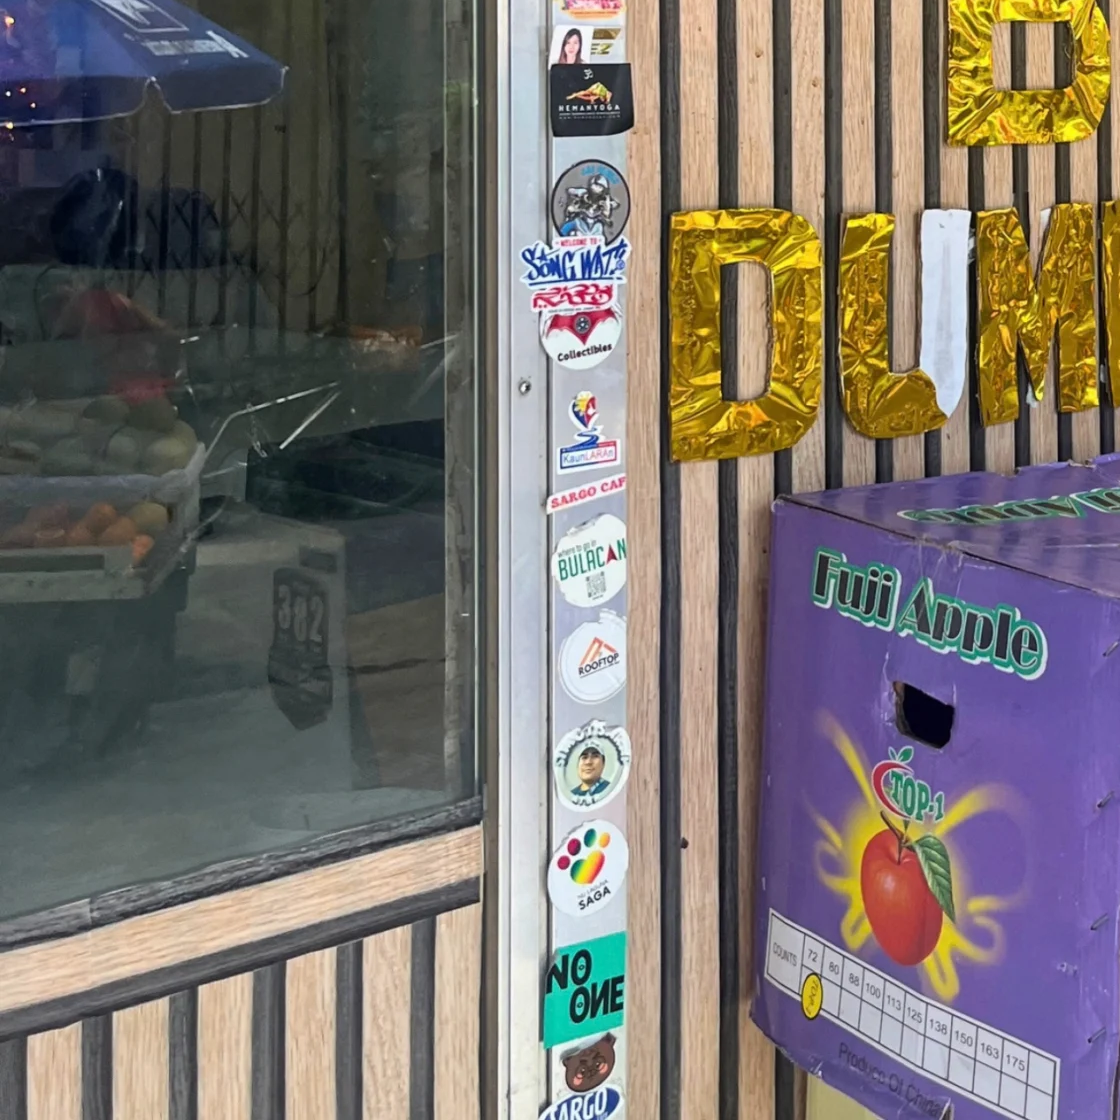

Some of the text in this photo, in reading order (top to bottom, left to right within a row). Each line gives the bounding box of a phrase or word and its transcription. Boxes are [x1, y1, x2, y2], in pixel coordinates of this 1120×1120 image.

[557, 344, 613, 362] Collectibles
[551, 486, 597, 509] SARGO
[813, 548, 1046, 676] Fuji Apple
[578, 652, 619, 676] ROOFTOP
[890, 770, 945, 823] TOP-1
[578, 886, 612, 910] SAGA
[545, 949, 593, 995] NO
[773, 942, 1026, 1072] COUNTS 72 80 88 100 113 125 138 150 163 175
